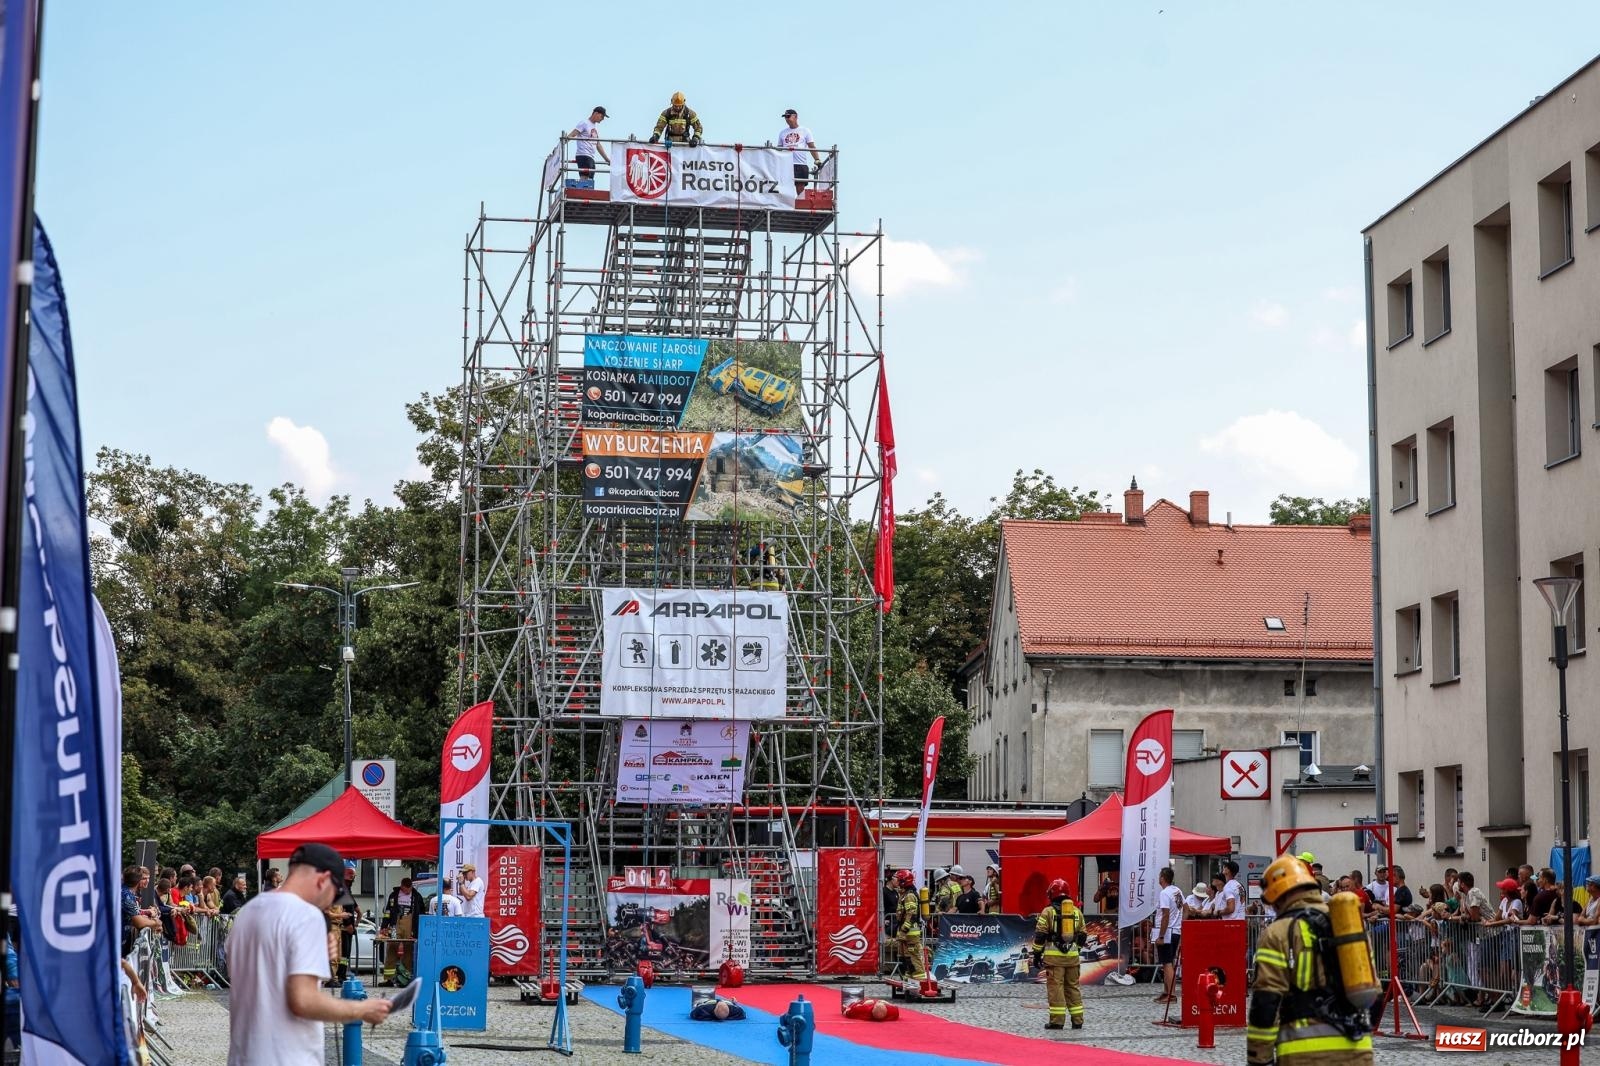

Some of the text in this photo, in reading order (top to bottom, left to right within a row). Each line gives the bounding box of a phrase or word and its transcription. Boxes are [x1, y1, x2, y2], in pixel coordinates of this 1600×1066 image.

[683, 161, 734, 172] MIASTO
[681, 172, 780, 194] Racibórz
[588, 340, 701, 355] KARCZOWANIE ZAROŚLI
[605, 355, 649, 368] KOSZENIE
[586, 370, 636, 384] KOSIARKA
[604, 390, 682, 406] 501 747 994
[587, 409, 676, 424] koparkiraciborz.pl
[586, 434, 705, 454] WYBURZENIA
[604, 466, 693, 481] 501 747 994
[608, 487, 680, 497] @koparkiraciborz
[586, 504, 680, 517] koparkiraciborz.pl
[648, 602, 782, 620] ARPAPOL
[612, 685, 662, 693] KOMPLEKSOWA
[663, 686, 696, 694] SPRZEDAŻ
[698, 687, 727, 695] SPRZĘTU
[661, 697, 726, 705] WWW.ARPAPOL.PL
[1137, 807, 1148, 908] VANESSA
[659, 869, 668, 886] 2
[500, 855, 508, 916] REKORD
[509, 856, 517, 916] RESCUE
[839, 857, 847, 917] REKORD
[848, 857, 856, 916] RESCUE
[1128, 871, 1136, 909] RADIO
[950, 924, 1001, 937] ostrog.net
[426, 1004, 477, 1017] SCZECIN
[1191, 1004, 1237, 1015] SECIN
